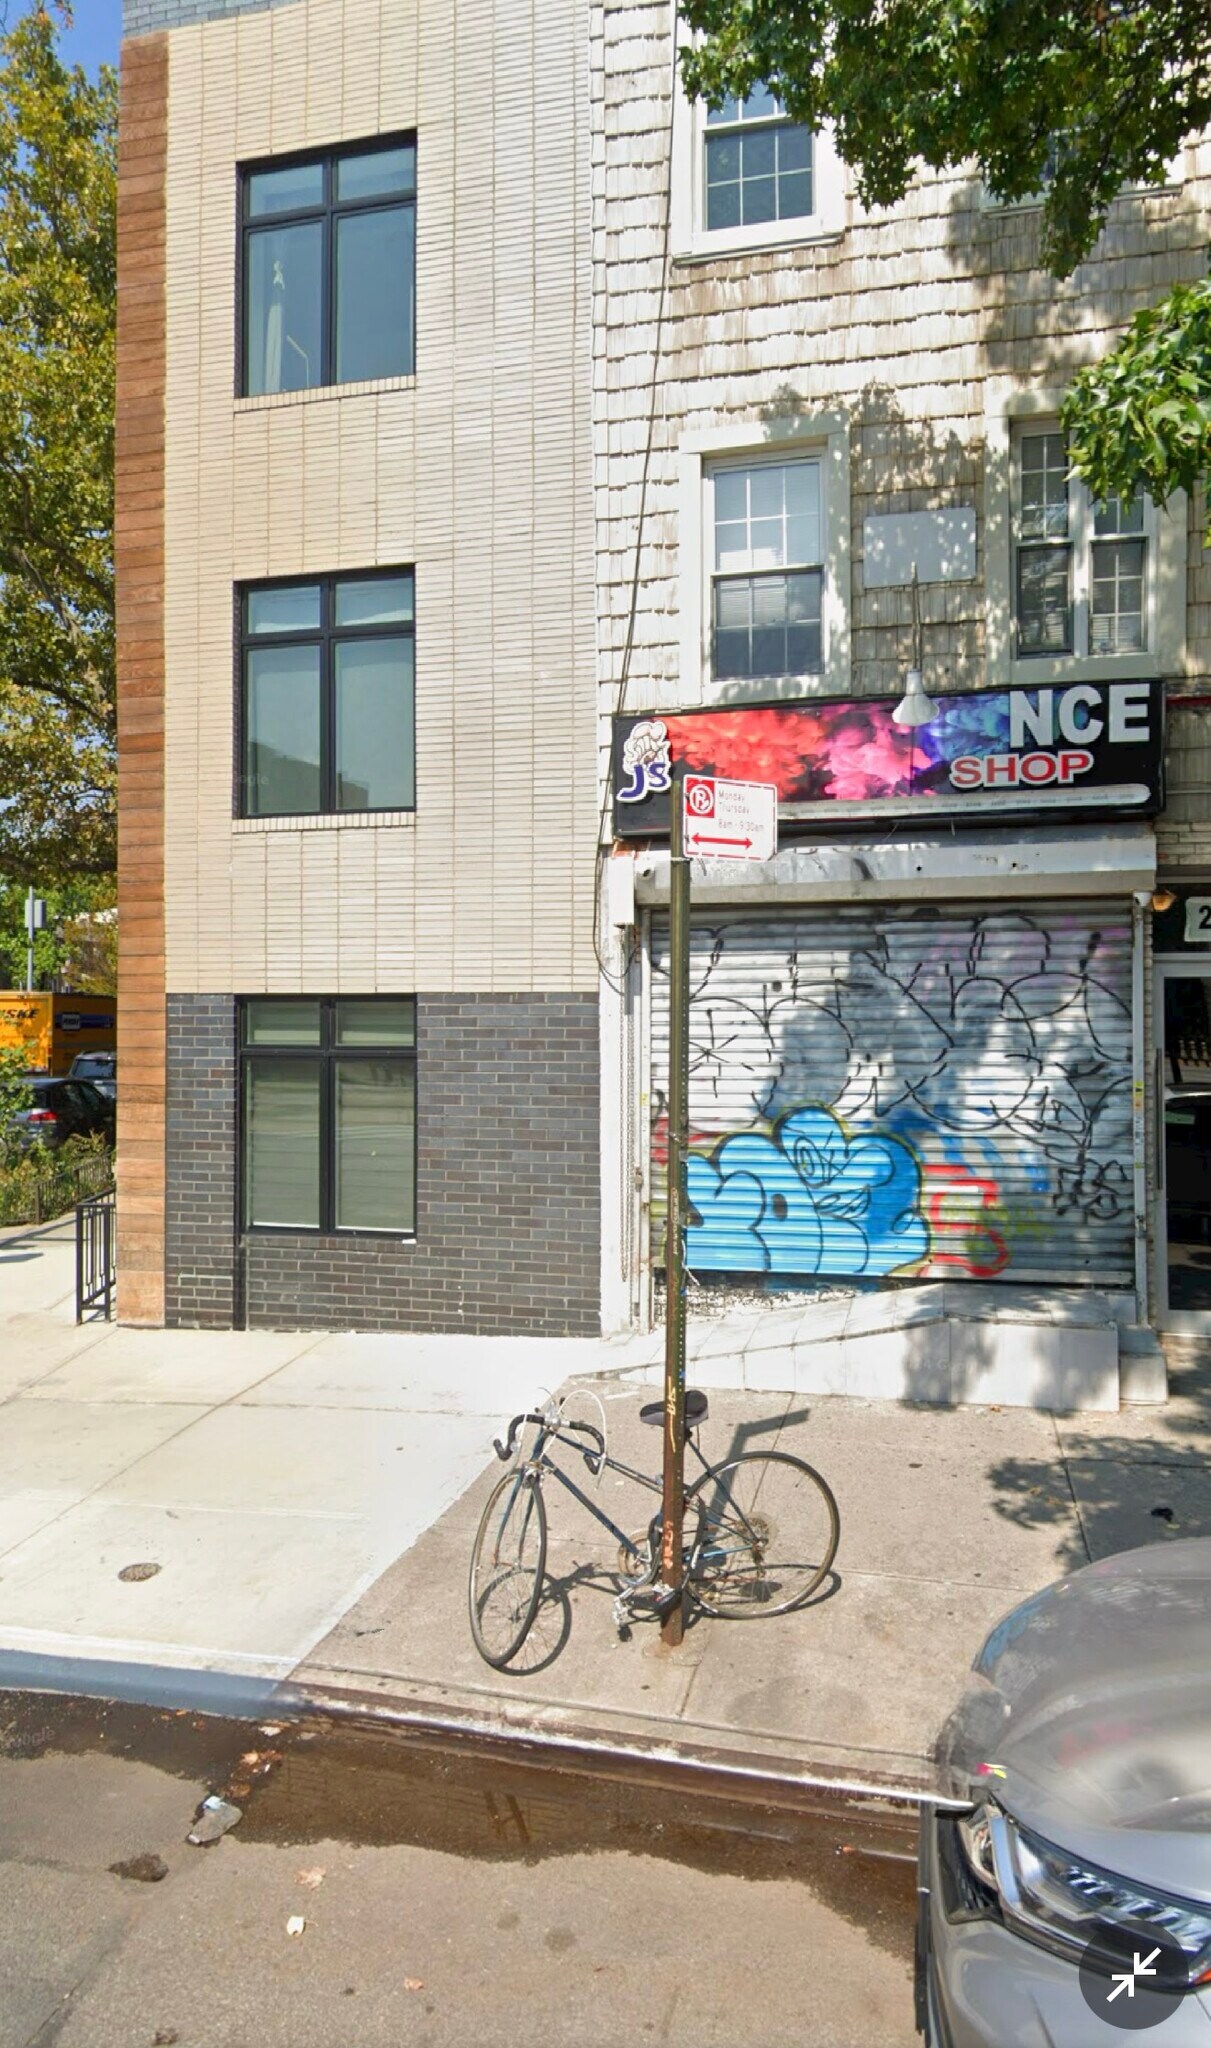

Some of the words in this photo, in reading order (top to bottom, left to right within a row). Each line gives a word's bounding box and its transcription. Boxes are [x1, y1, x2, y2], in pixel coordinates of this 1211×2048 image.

[1010, 683, 1150, 748] NCE
[951, 751, 1093, 787] SHOP
[718, 789, 745, 802] Monday
